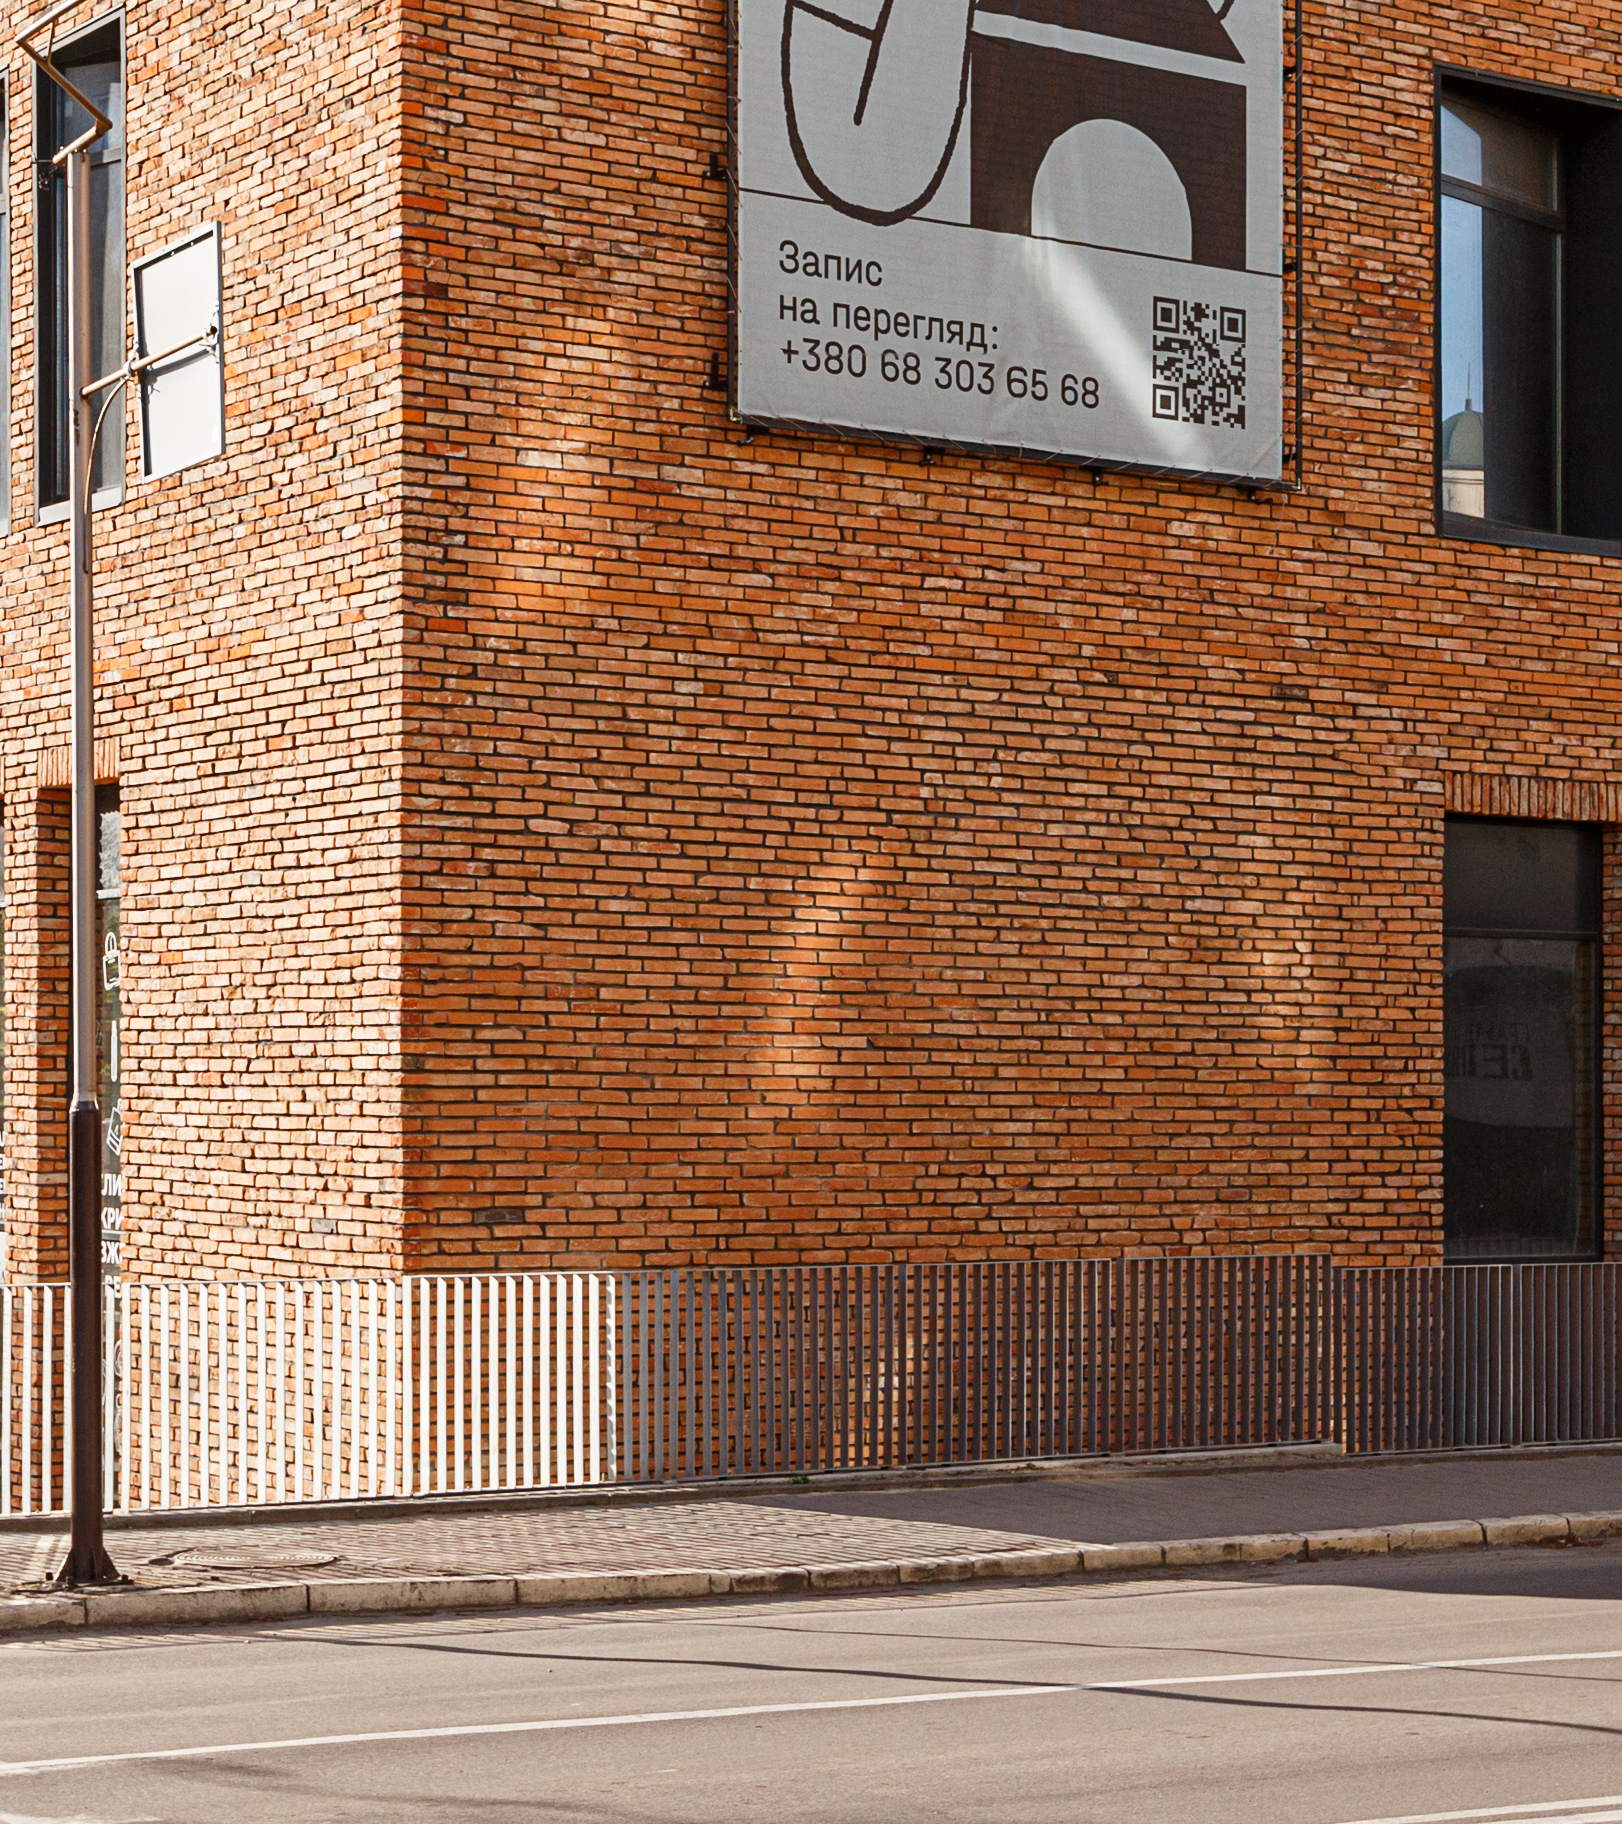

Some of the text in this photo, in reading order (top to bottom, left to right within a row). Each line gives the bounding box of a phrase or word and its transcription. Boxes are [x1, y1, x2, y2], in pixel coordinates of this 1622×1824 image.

[779, 240, 883, 286] Запис
[779, 295, 999, 356] на перегляд:
[780, 339, 1100, 409] +380 68 303 65 68
